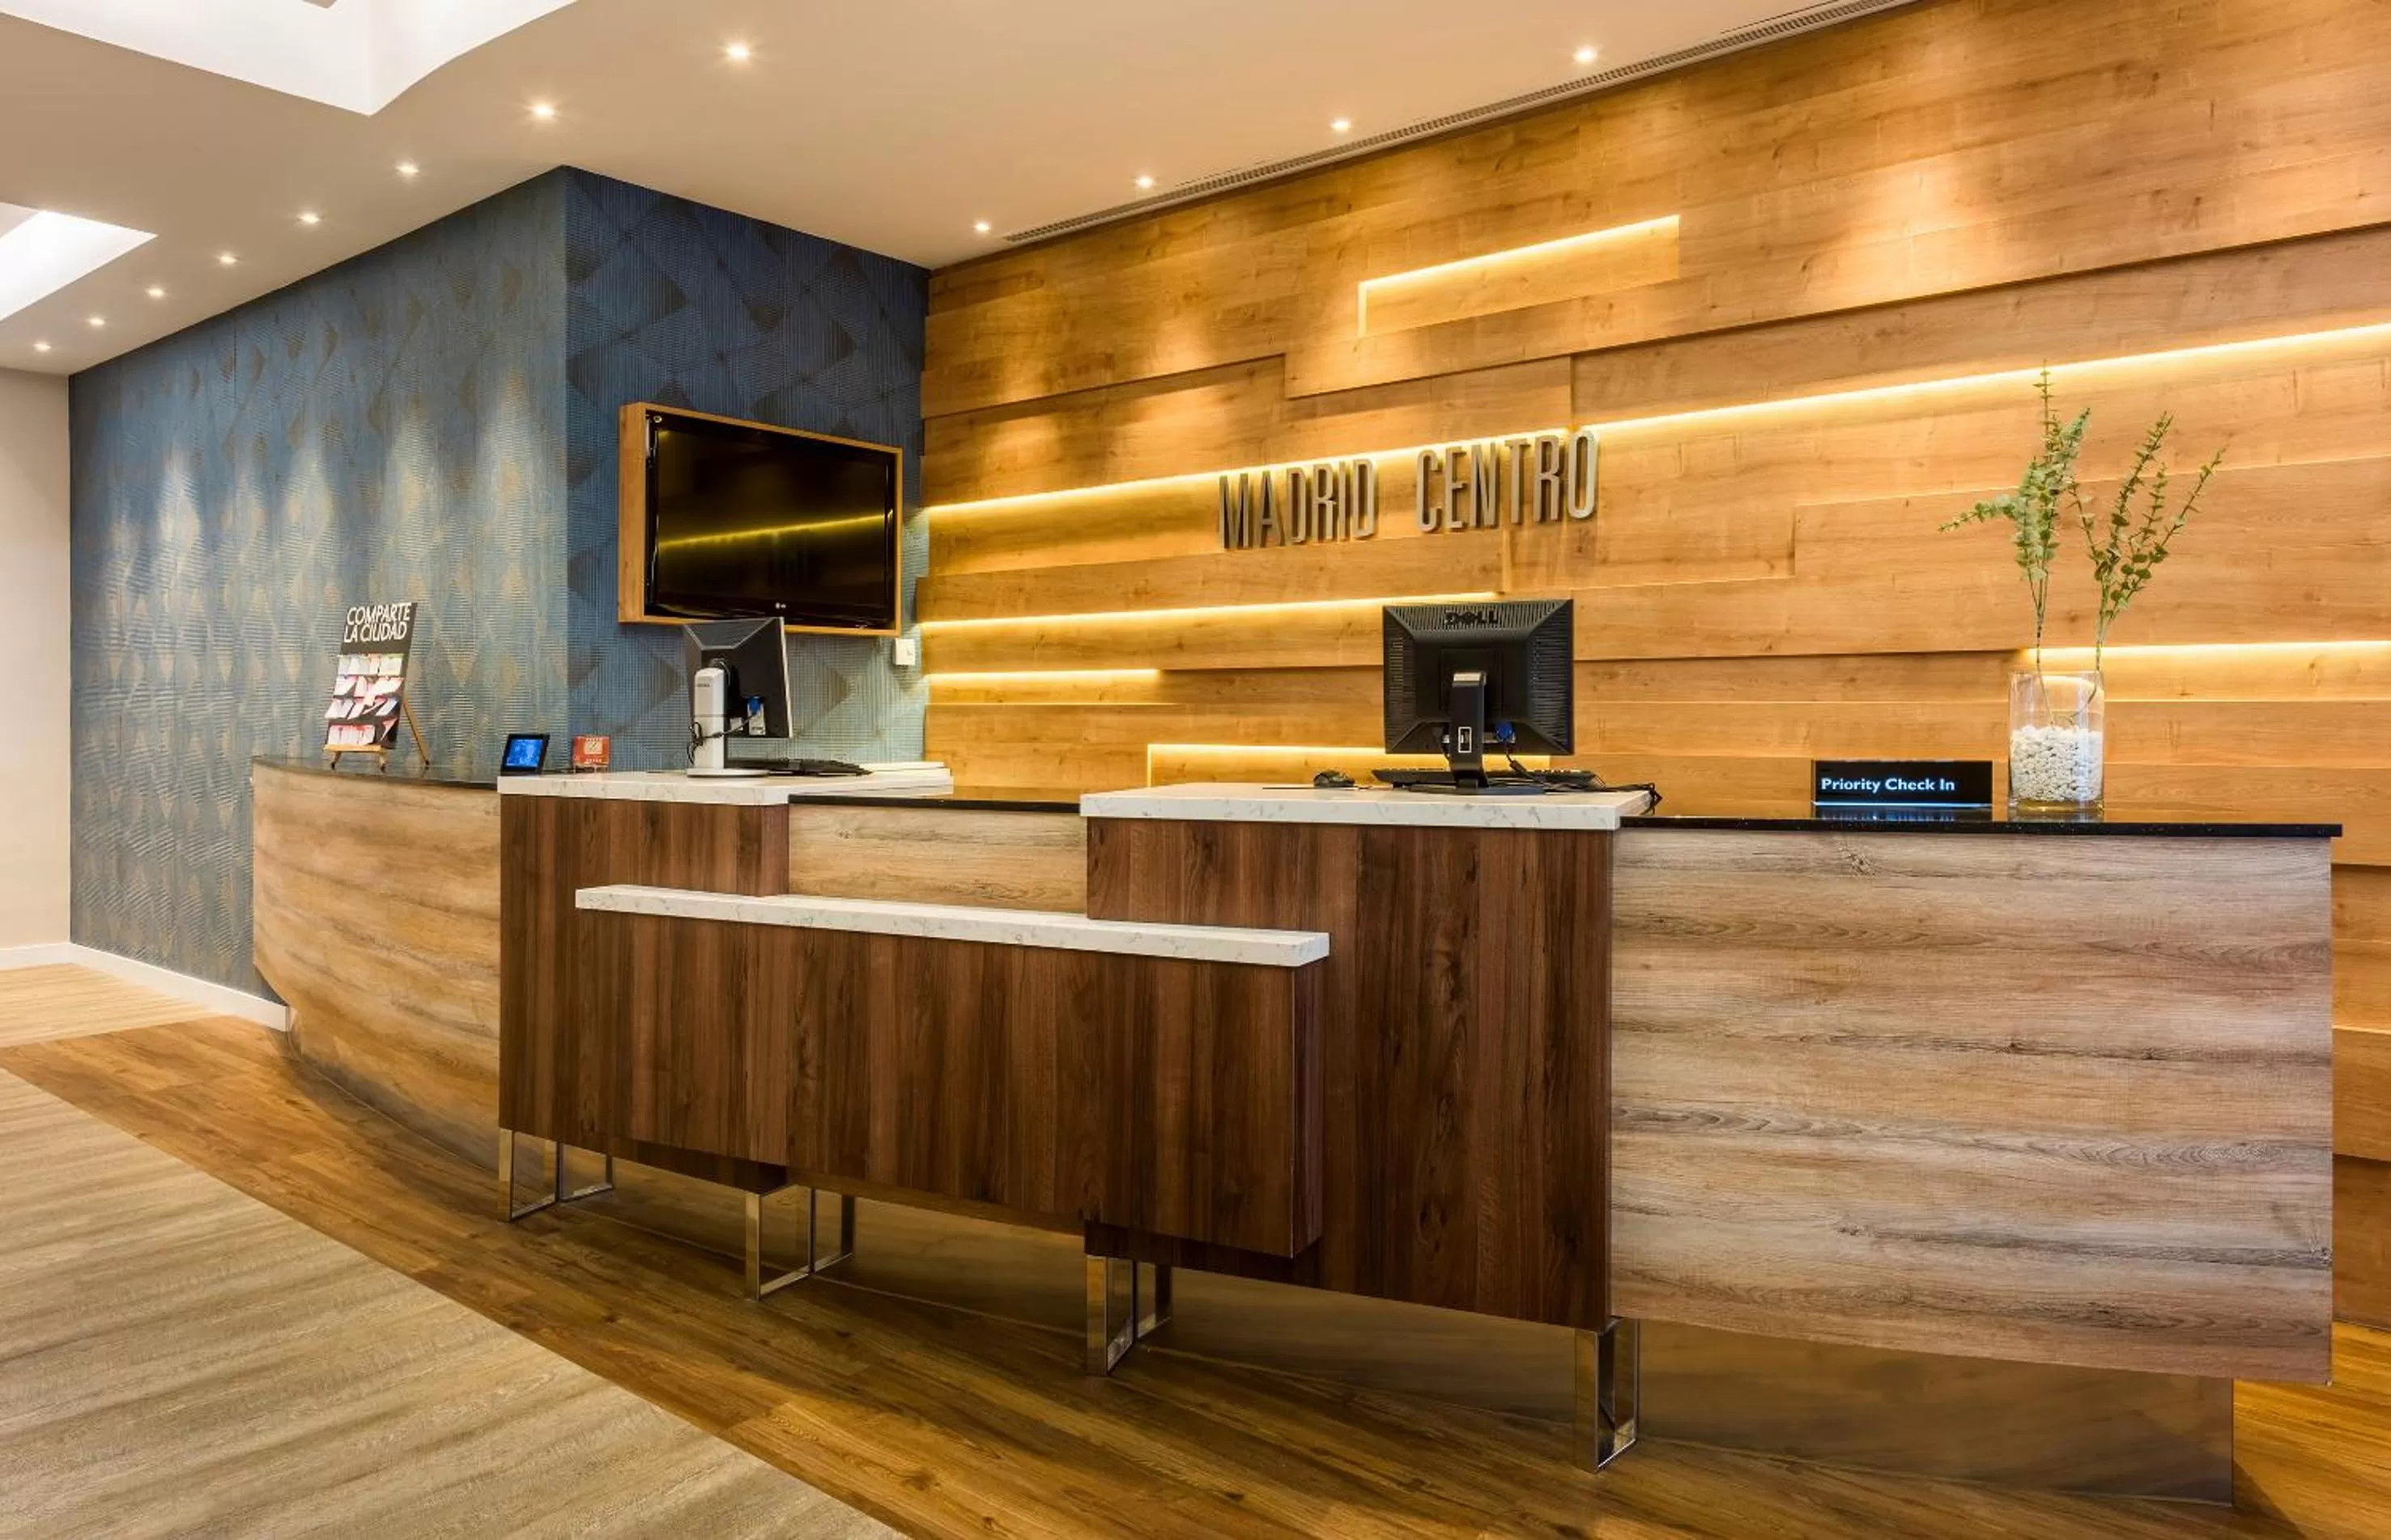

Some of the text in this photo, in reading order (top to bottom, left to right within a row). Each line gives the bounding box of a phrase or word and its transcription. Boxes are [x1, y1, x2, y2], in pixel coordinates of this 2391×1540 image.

[1219, 430, 1599, 549] MADRID CENTRO
[347, 602, 411, 625] COMPARTE
[1444, 610, 1499, 625] DELL
[344, 621, 407, 643] LA CIUDAD
[1821, 777, 1955, 793] Priority Check In
